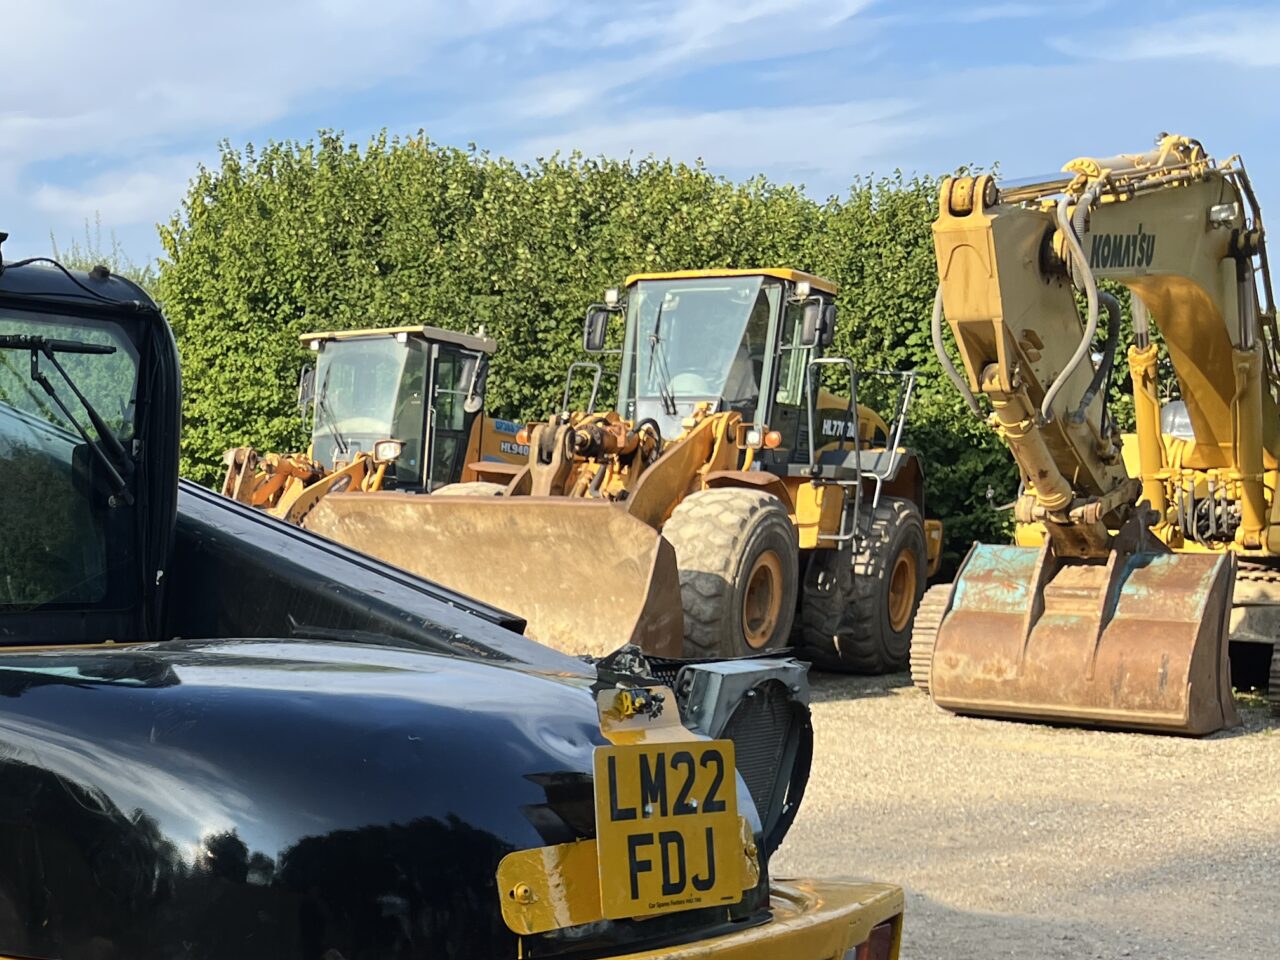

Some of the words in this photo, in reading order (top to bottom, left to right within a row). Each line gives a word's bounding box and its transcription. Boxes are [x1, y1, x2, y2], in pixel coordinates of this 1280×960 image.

[1089, 223, 1156, 269] KOMATSU
[500, 441, 529, 456] HL940
[607, 749, 726, 822] LM22
[627, 826, 716, 900] FDJ
